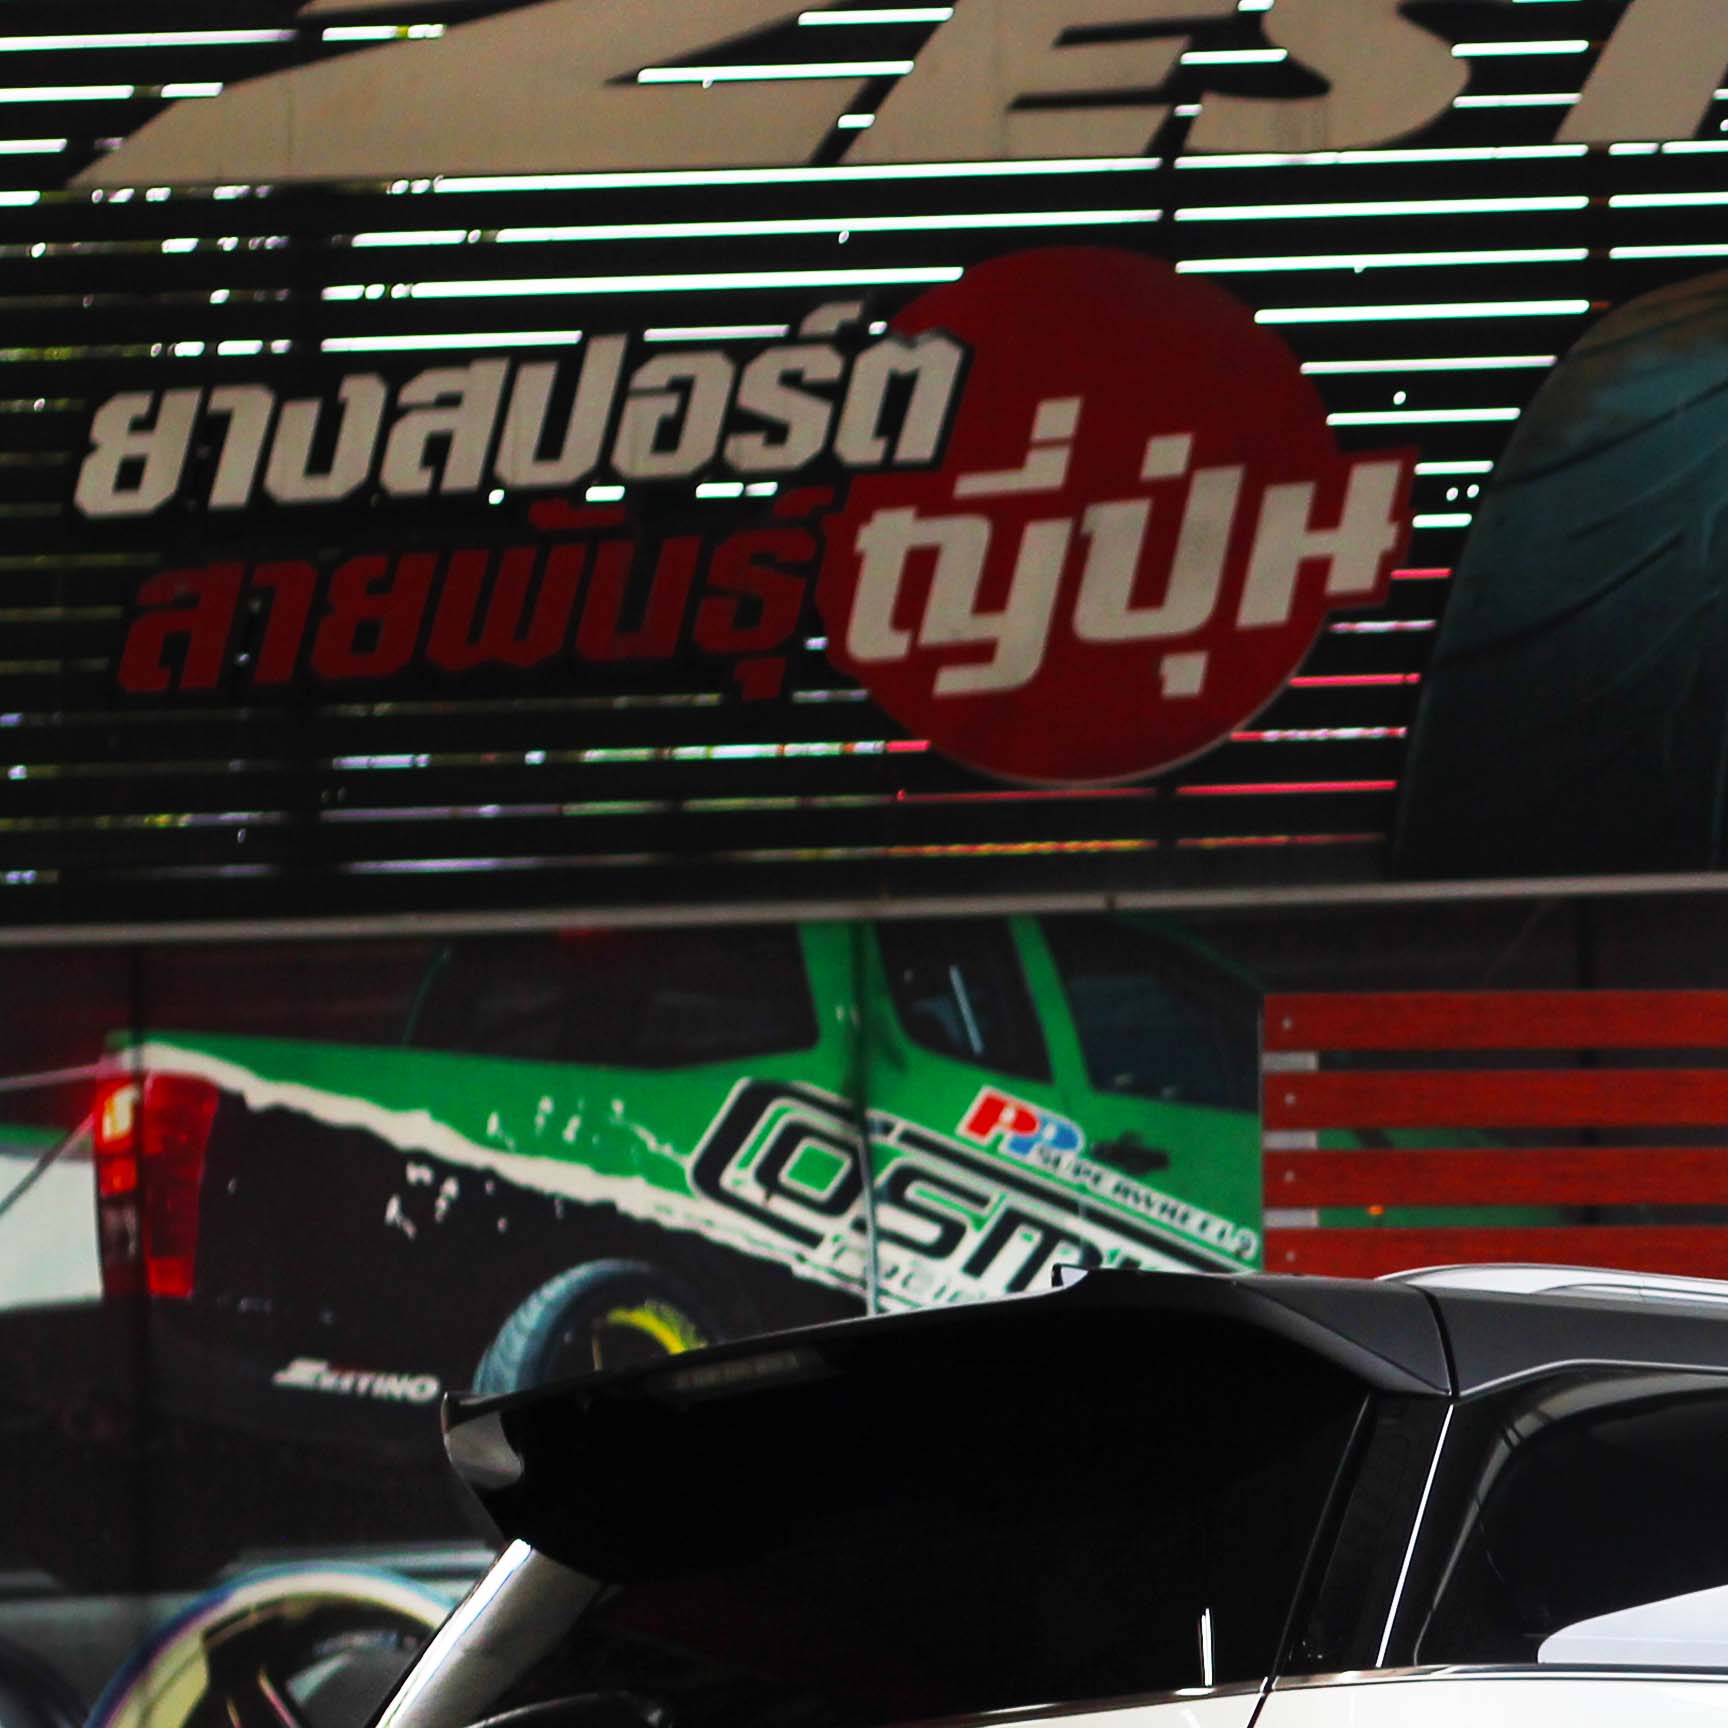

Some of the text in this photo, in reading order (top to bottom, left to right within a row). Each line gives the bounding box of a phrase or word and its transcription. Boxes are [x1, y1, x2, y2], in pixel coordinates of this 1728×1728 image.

[74, 300, 967, 520] ยางสปอร์ต
[115, 396, 1403, 701] สายพันธุ์ ญี่ปุ่น
